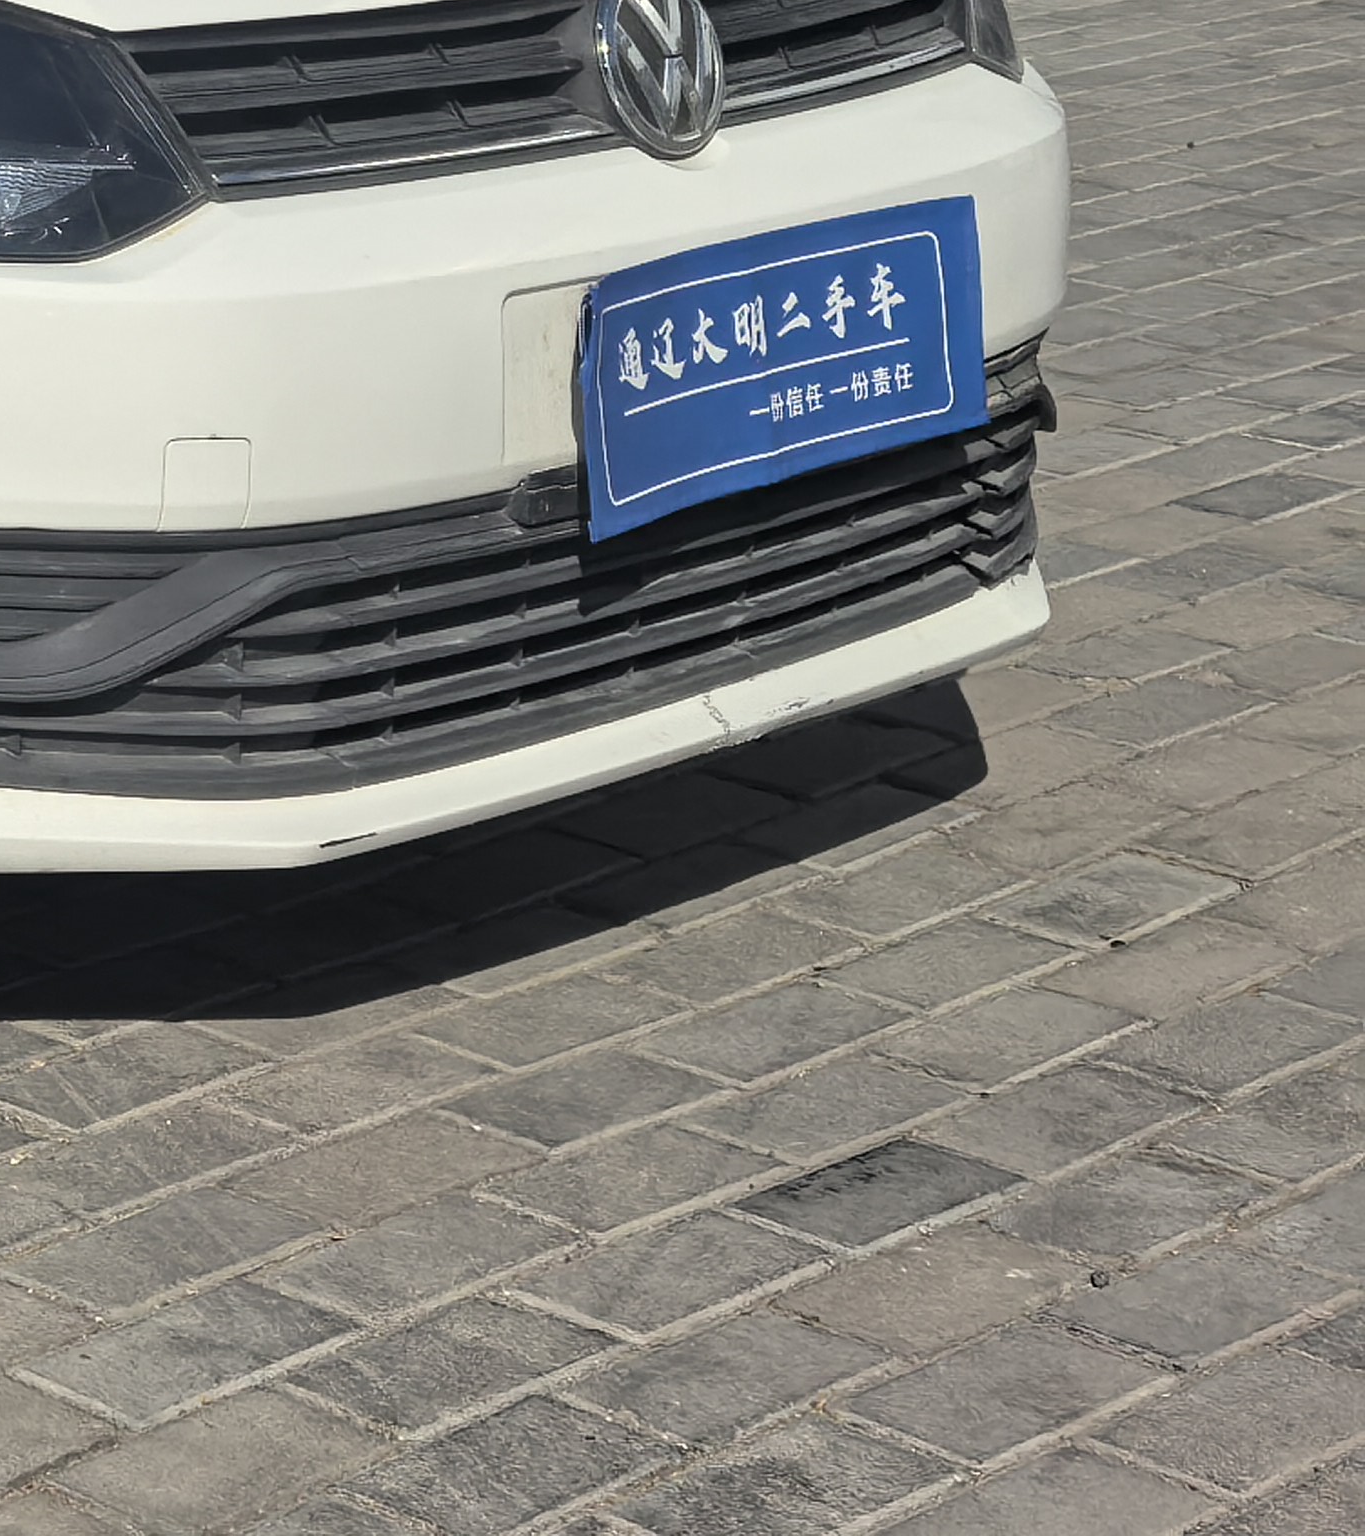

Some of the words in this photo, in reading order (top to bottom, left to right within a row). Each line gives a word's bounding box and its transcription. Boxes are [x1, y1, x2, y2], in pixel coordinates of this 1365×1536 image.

[617, 263, 906, 391] 通辽大明二手车
